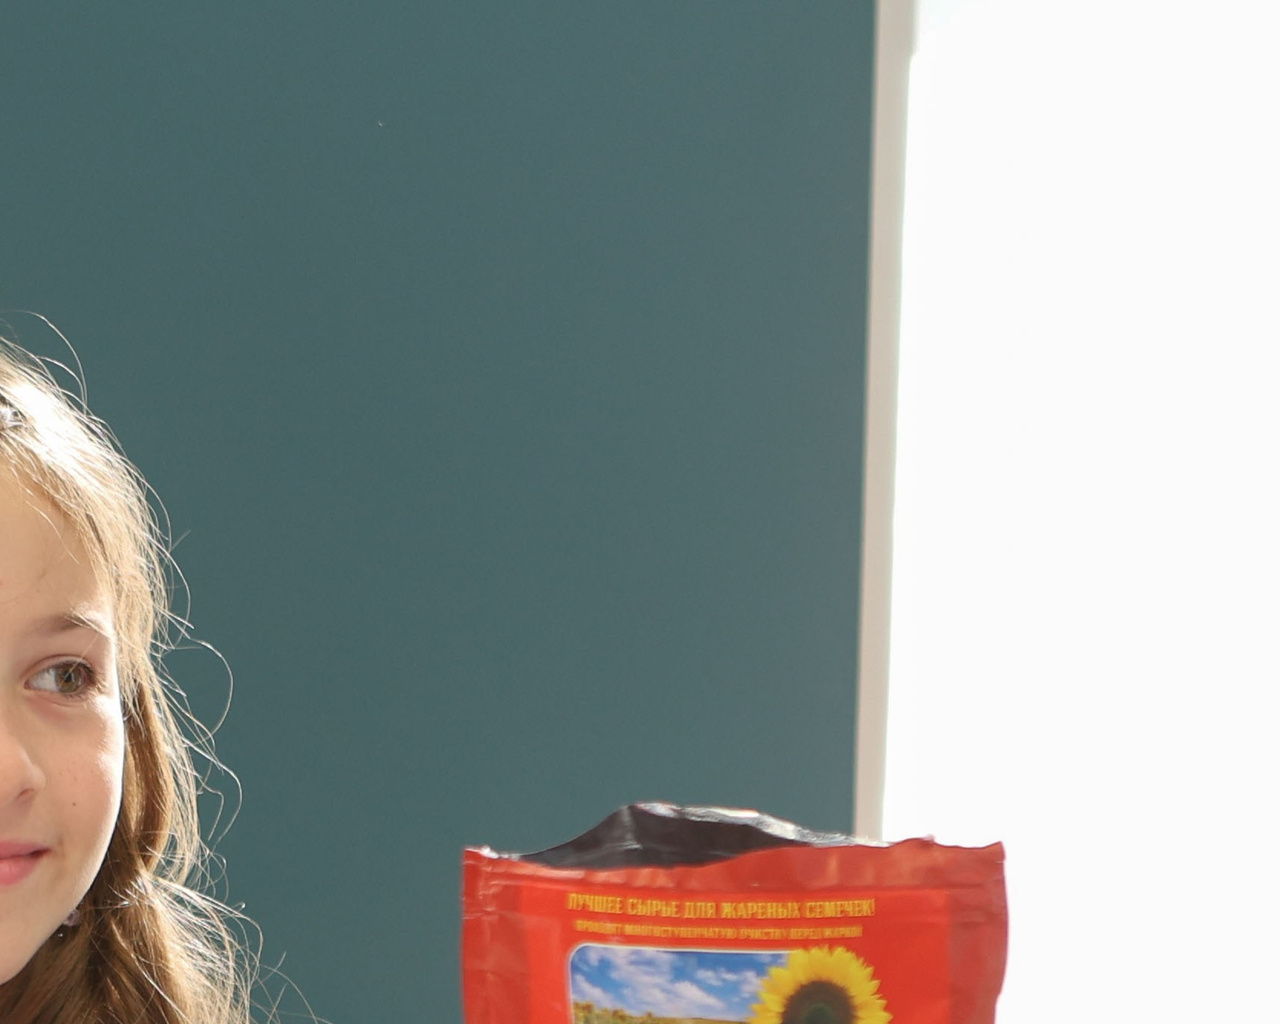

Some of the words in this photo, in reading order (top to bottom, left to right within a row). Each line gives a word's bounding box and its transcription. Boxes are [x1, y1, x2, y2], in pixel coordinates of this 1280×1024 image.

[566, 893, 623, 914] ЛУЧШЕЕ
[684, 902, 717, 919] ДЛЯ
[720, 902, 801, 919] ЖАРЕНЫХ
